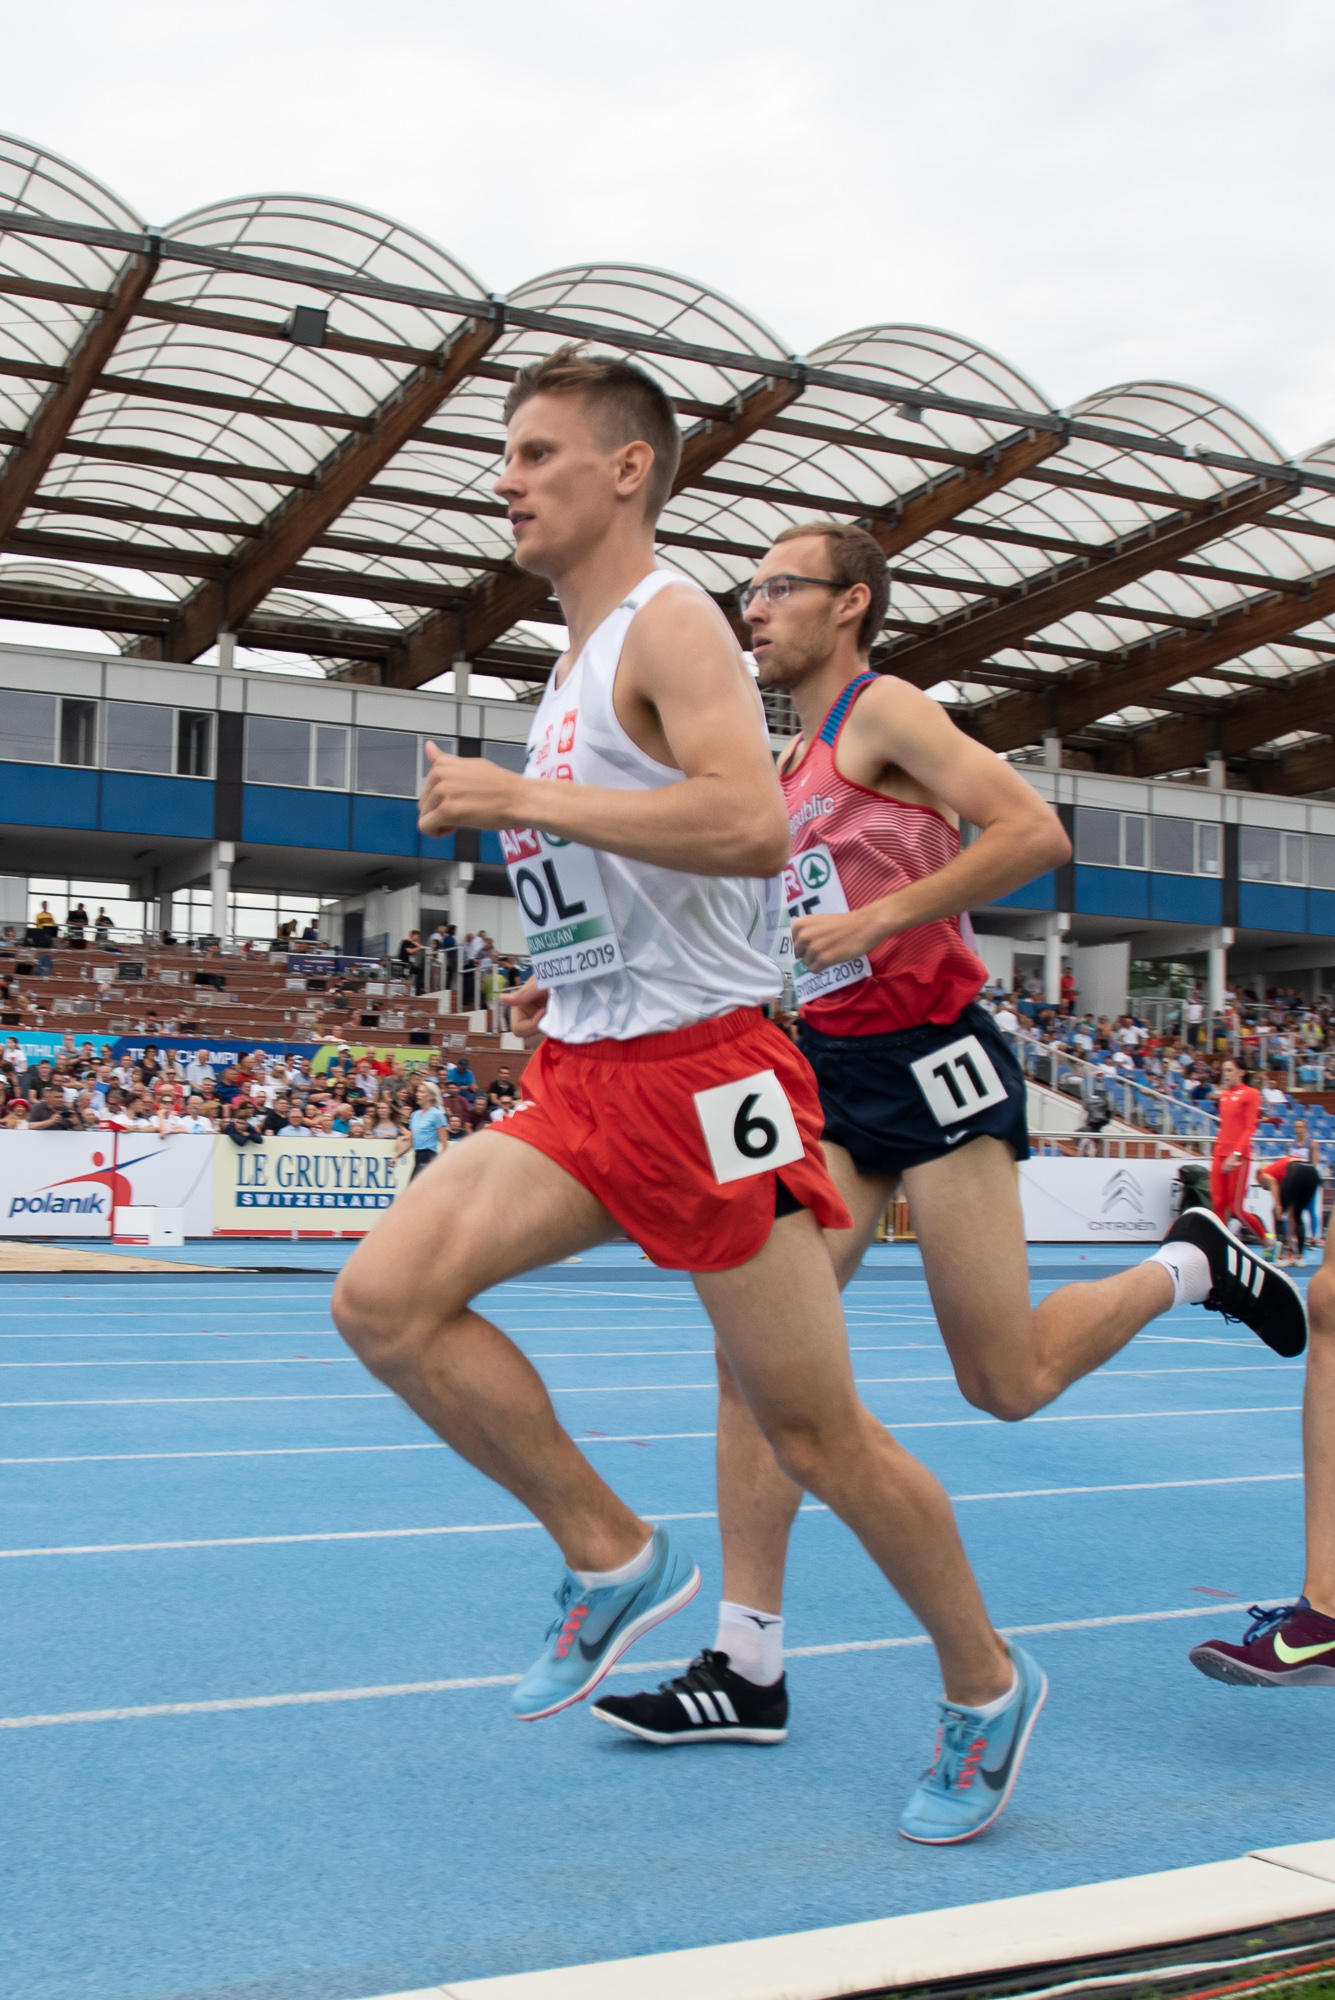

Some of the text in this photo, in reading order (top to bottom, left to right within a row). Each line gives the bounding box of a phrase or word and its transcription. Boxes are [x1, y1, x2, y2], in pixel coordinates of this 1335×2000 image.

[516, 858, 588, 927] OL
[544, 926, 575, 949] CLEAN
[577, 943, 616, 971] 2019
[833, 958, 865, 982] 2019
[127, 1047, 170, 1062] TEM
[932, 1051, 990, 1109] 11
[733, 1093, 780, 1159] 6
[236, 1149, 399, 1189] LE GRUYÈRE
[8, 1192, 106, 1218] polanik
[241, 1192, 392, 1208] SWITZERLAND
